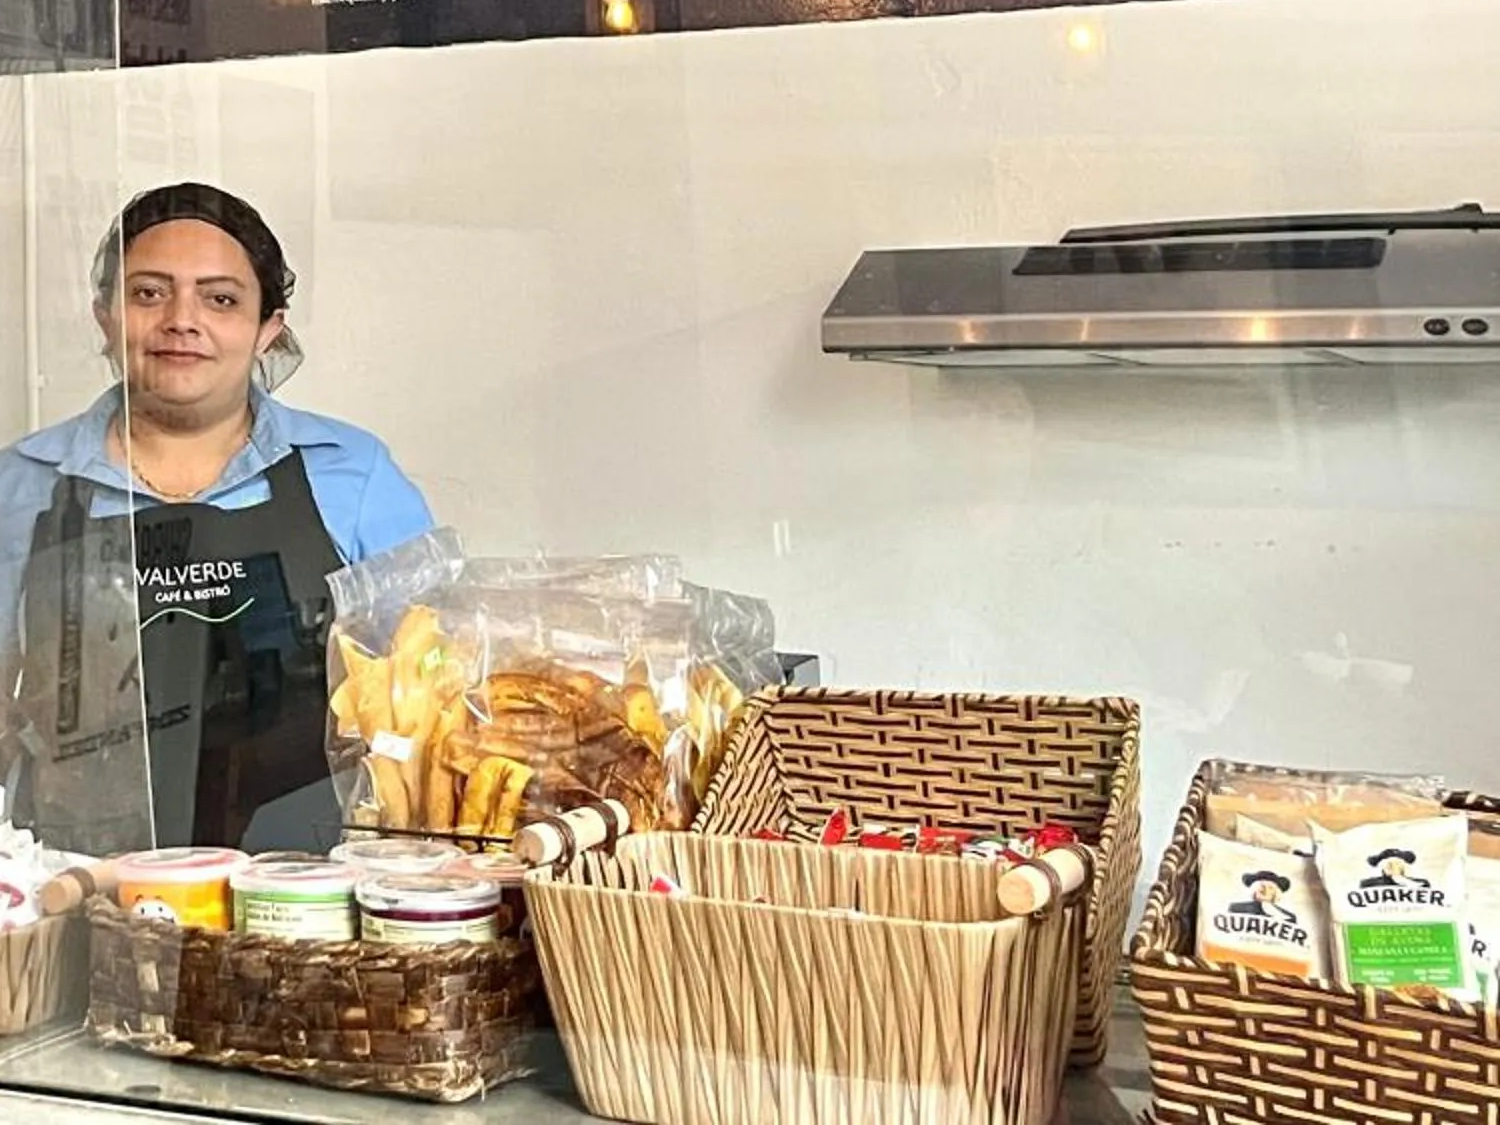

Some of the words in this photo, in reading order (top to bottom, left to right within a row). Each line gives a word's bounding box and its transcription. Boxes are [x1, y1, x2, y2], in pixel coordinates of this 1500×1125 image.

[135, 561, 247, 586] VALVERDE
[1348, 888, 1446, 909] QUAKER
[1213, 913, 1309, 947] QUAKER
